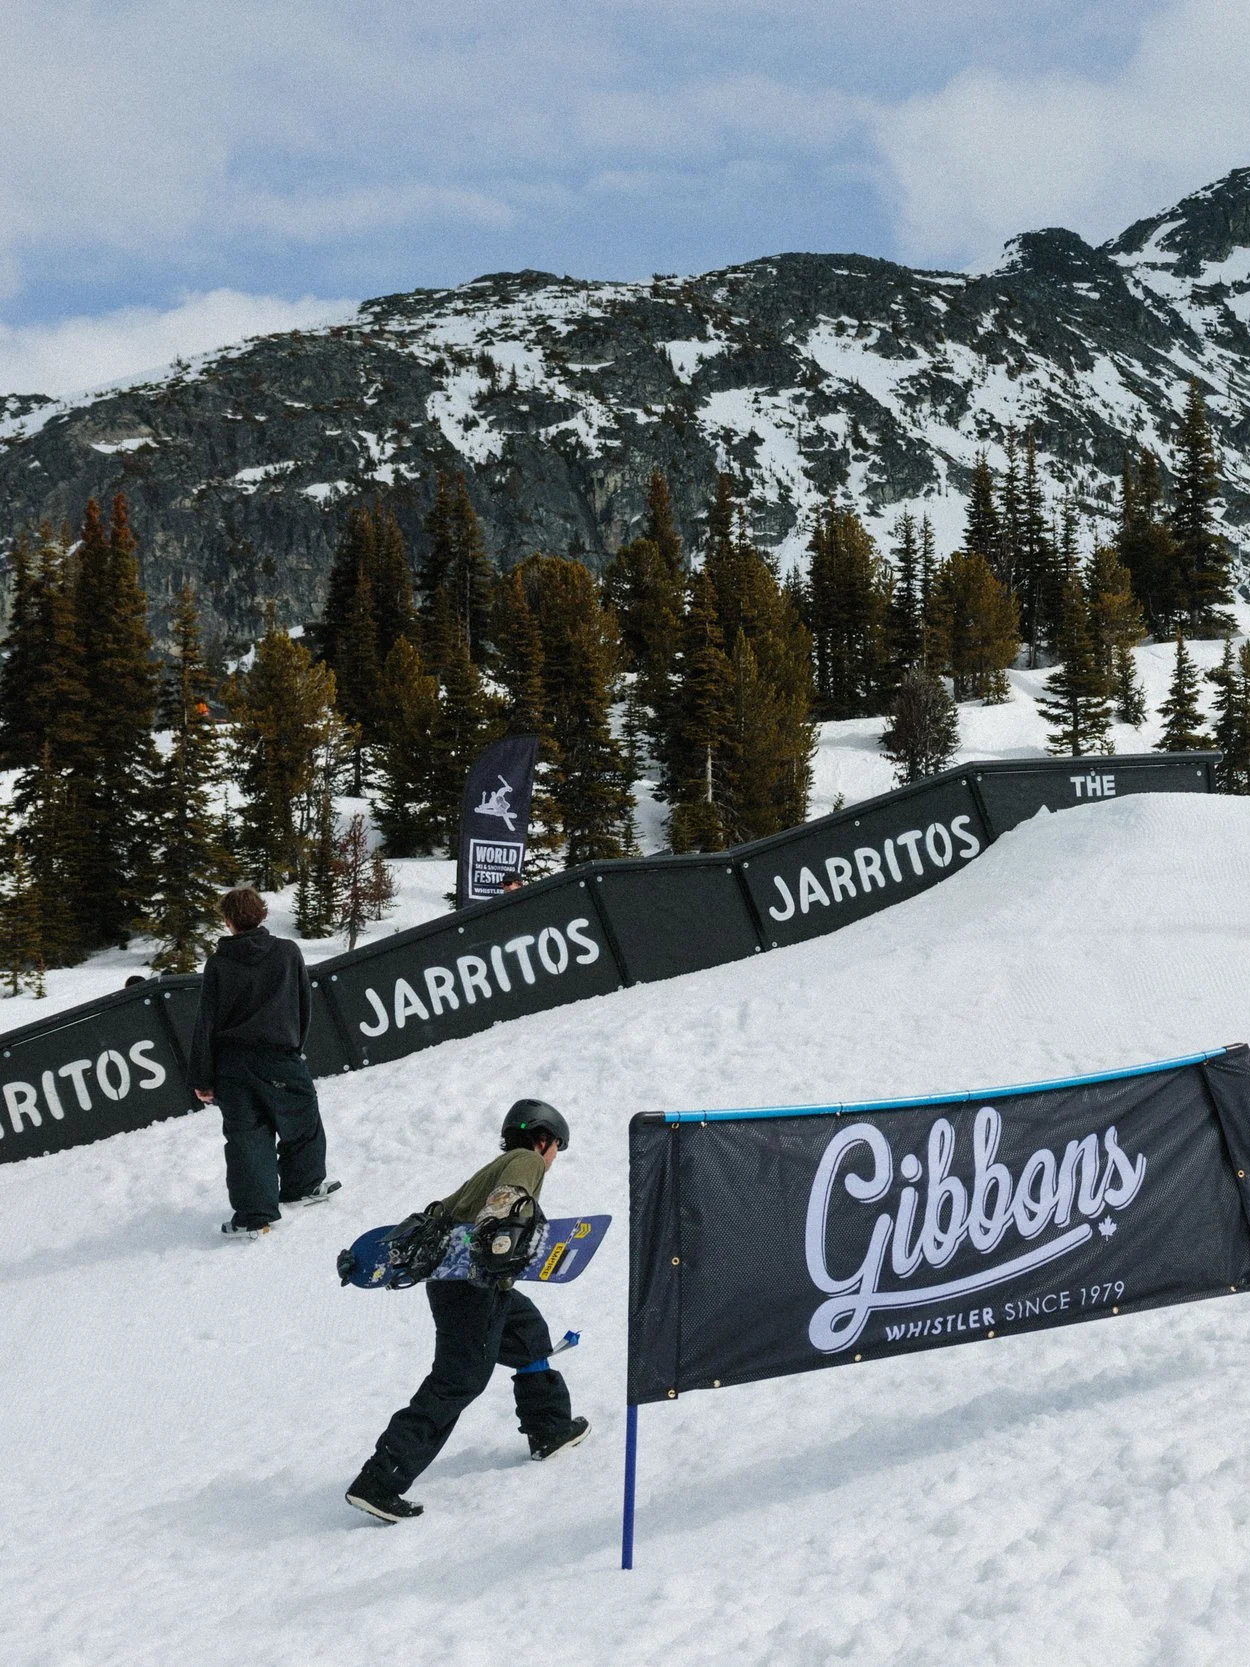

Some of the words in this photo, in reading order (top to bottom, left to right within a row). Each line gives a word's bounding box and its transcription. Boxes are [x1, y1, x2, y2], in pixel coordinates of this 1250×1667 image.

[1070, 775, 1116, 797] THE
[474, 870, 505, 884] FESTIV
[476, 846, 517, 864] WORLD
[769, 815, 980, 922] JARRITOS
[359, 918, 600, 1037] JARRITOS
[0, 1039, 166, 1140] RITOS
[804, 1106, 1147, 1354] Gibbons
[885, 1307, 996, 1342] WHISTLER
[1004, 1291, 1071, 1321] SINCE
[1080, 1281, 1125, 1305] 1979
